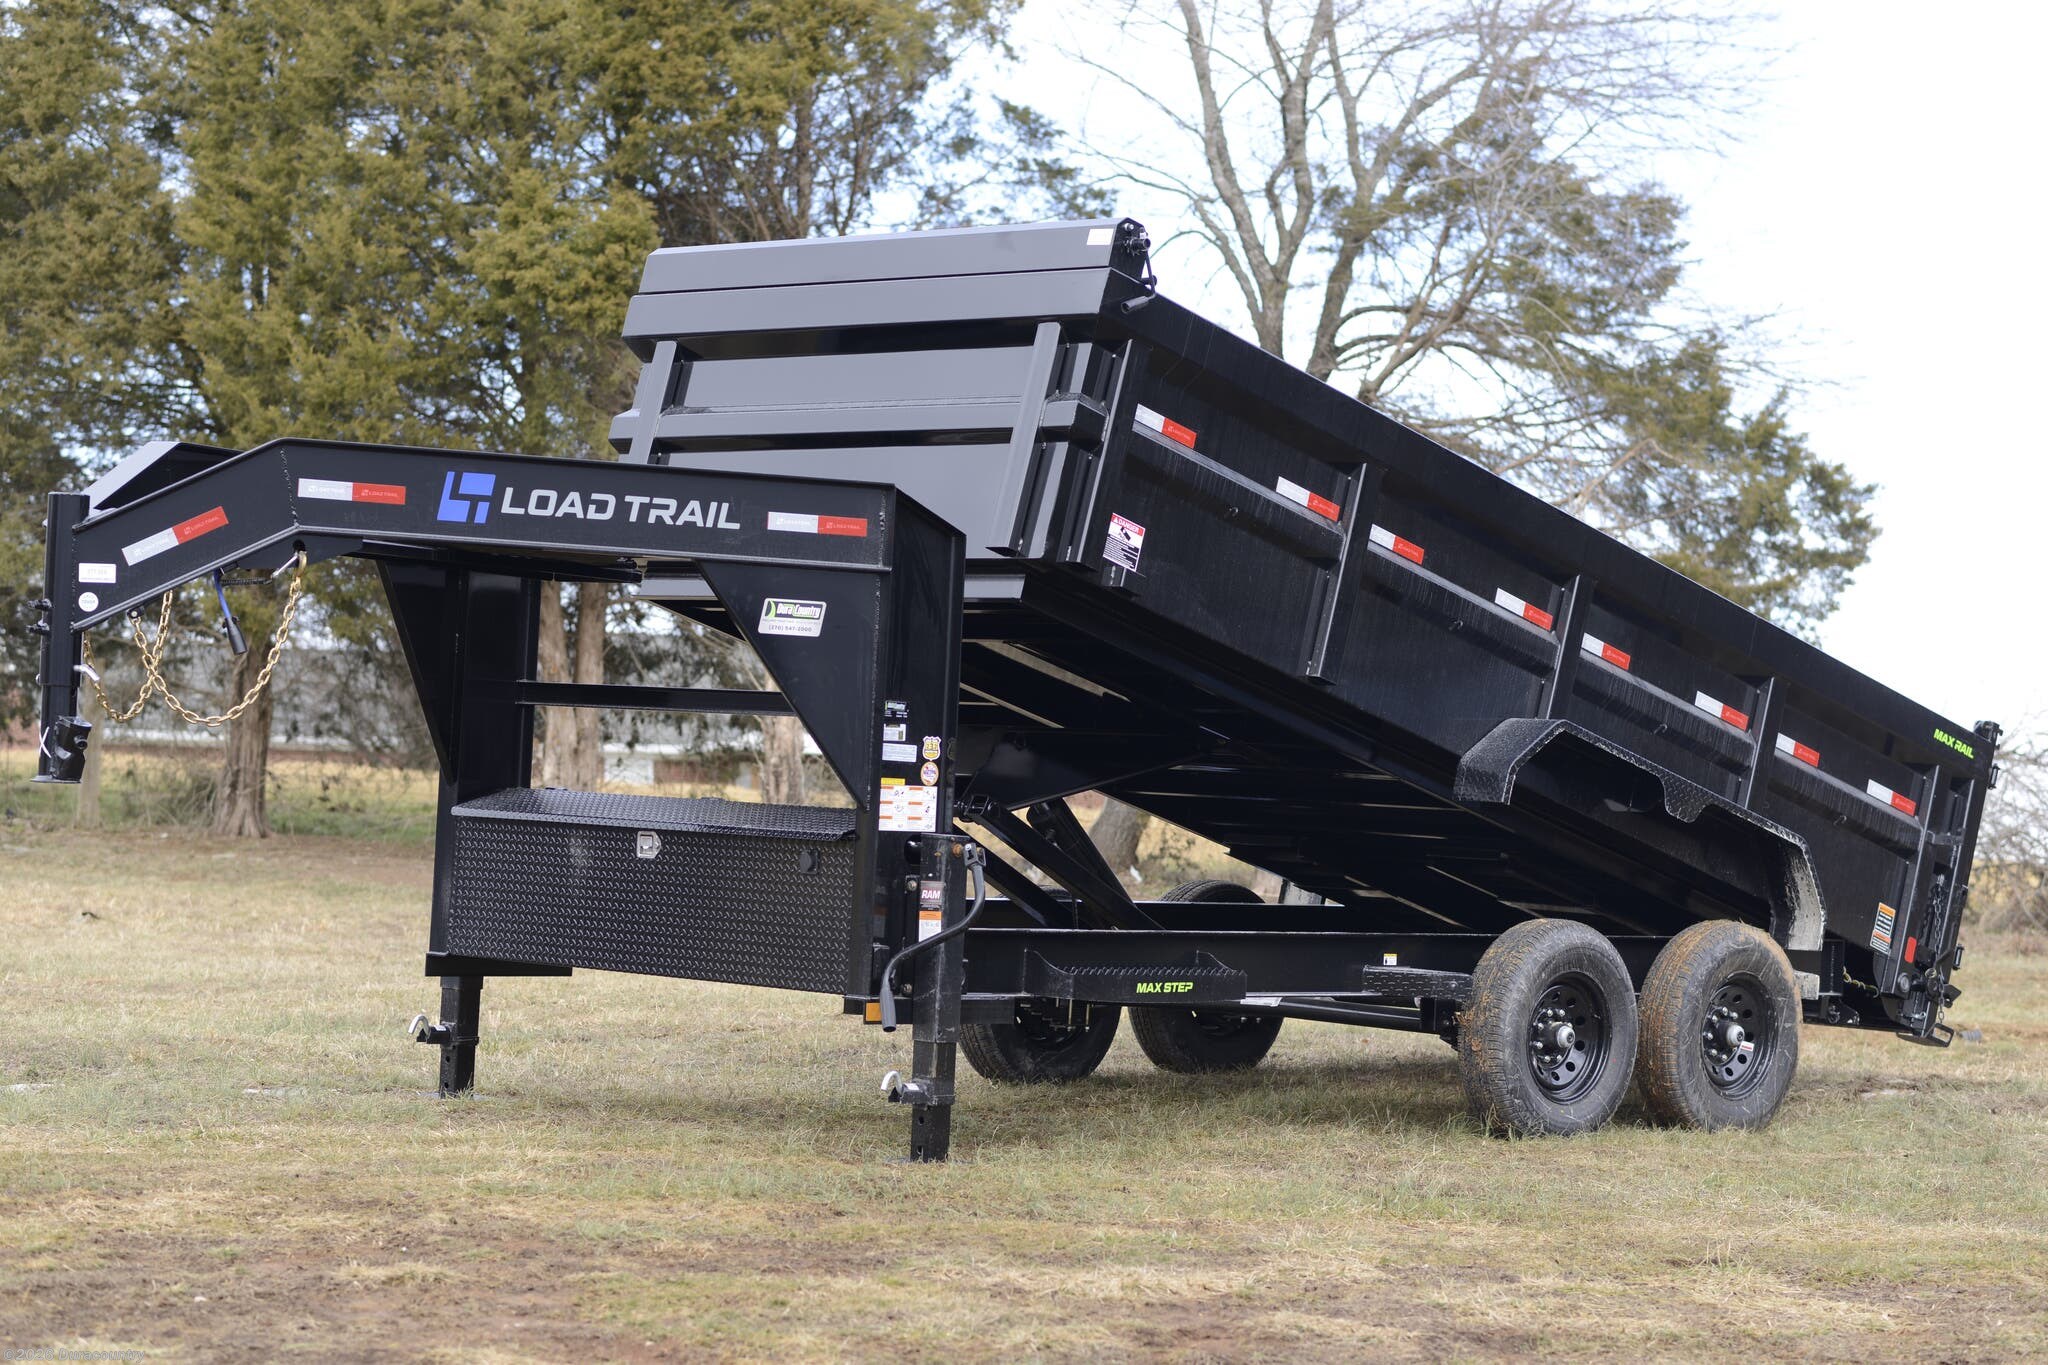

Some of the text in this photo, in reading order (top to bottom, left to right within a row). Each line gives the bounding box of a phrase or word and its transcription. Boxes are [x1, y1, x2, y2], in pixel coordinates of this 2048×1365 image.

[501, 487, 616, 520] LOAD
[624, 495, 741, 530] TRAIL
[795, 604, 822, 619] Country
[1933, 728, 1974, 759] MAX RAIL
[921, 889, 941, 899] RAM
[1136, 981, 1194, 994] MAX STEP
